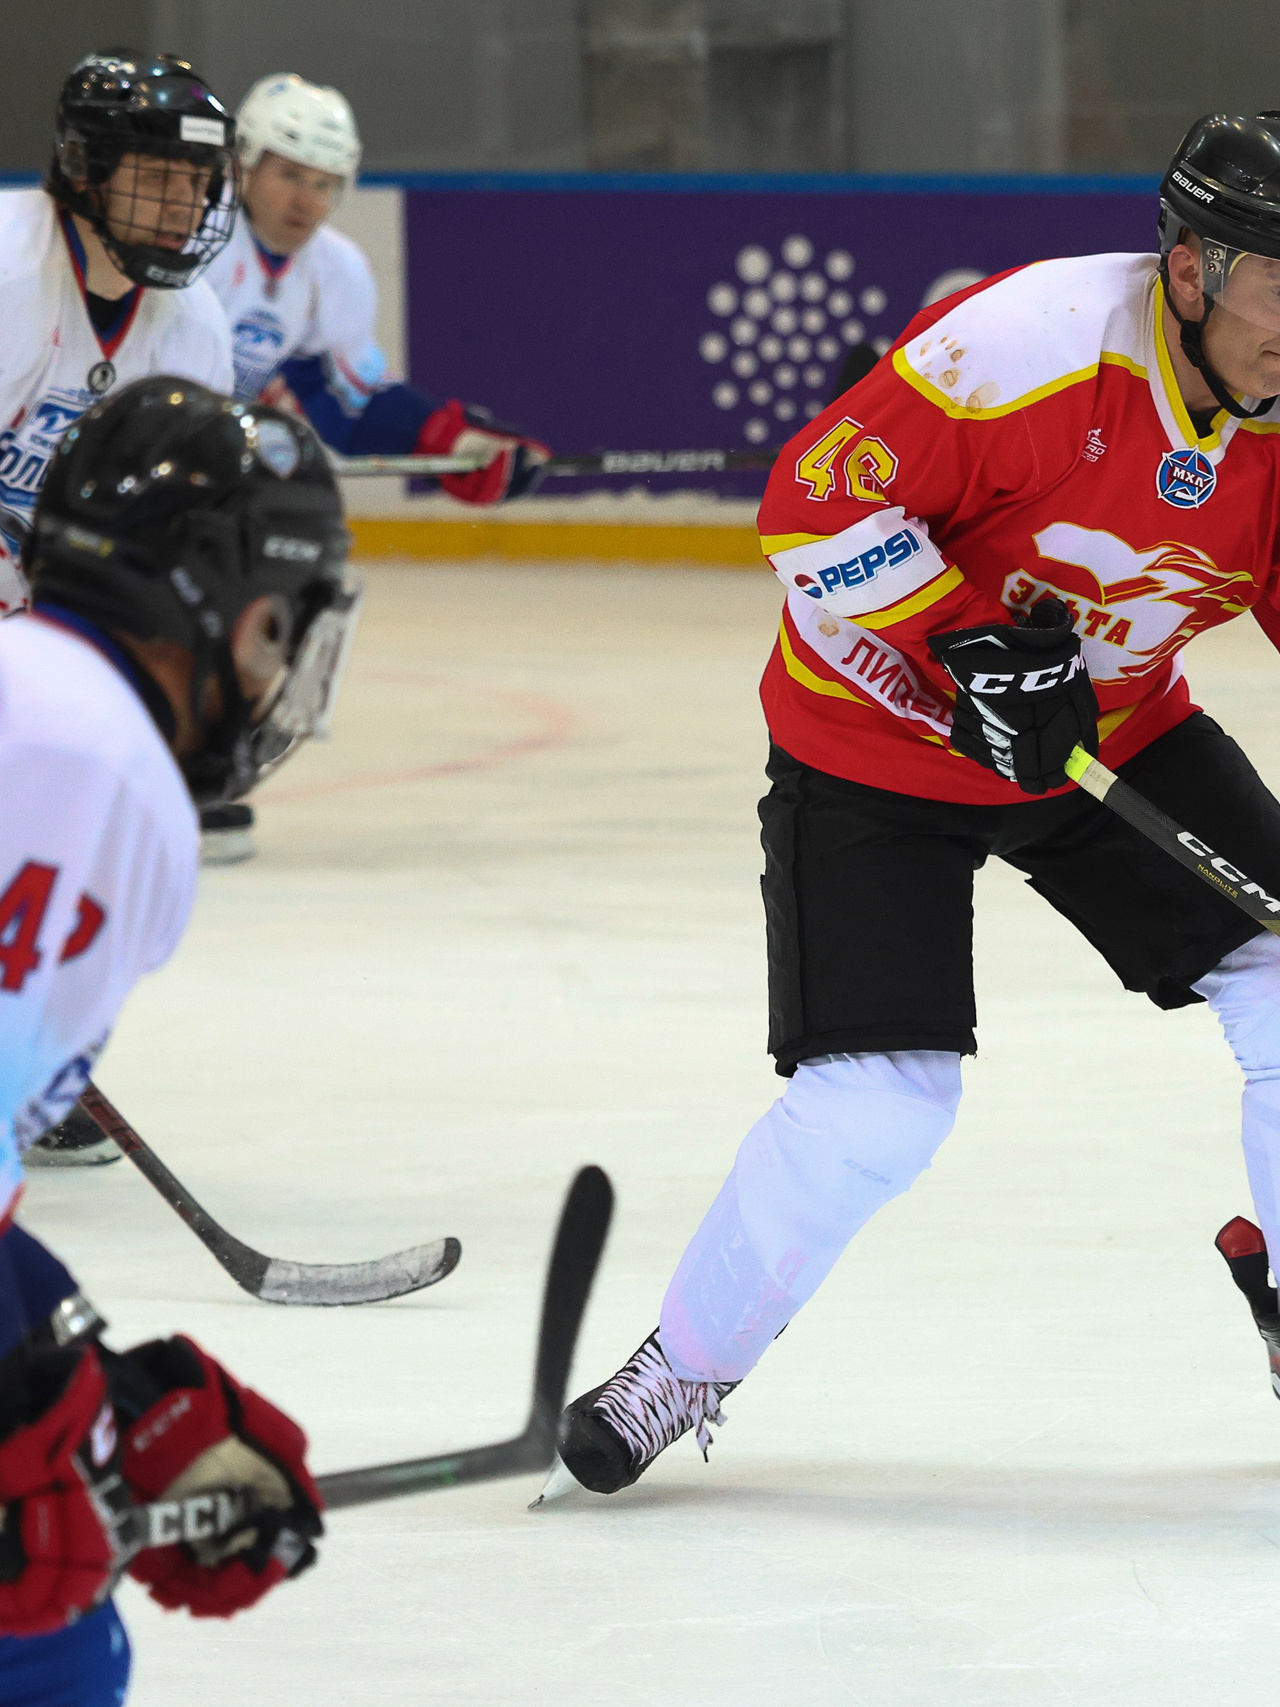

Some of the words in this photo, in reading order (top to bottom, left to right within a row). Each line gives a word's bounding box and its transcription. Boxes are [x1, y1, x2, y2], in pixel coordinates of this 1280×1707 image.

[1171, 170, 1215, 204] BAUER
[1173, 466, 1205, 488] МХЛ
[816, 528, 922, 594] PEPSI
[968, 653, 1086, 695] CCM
